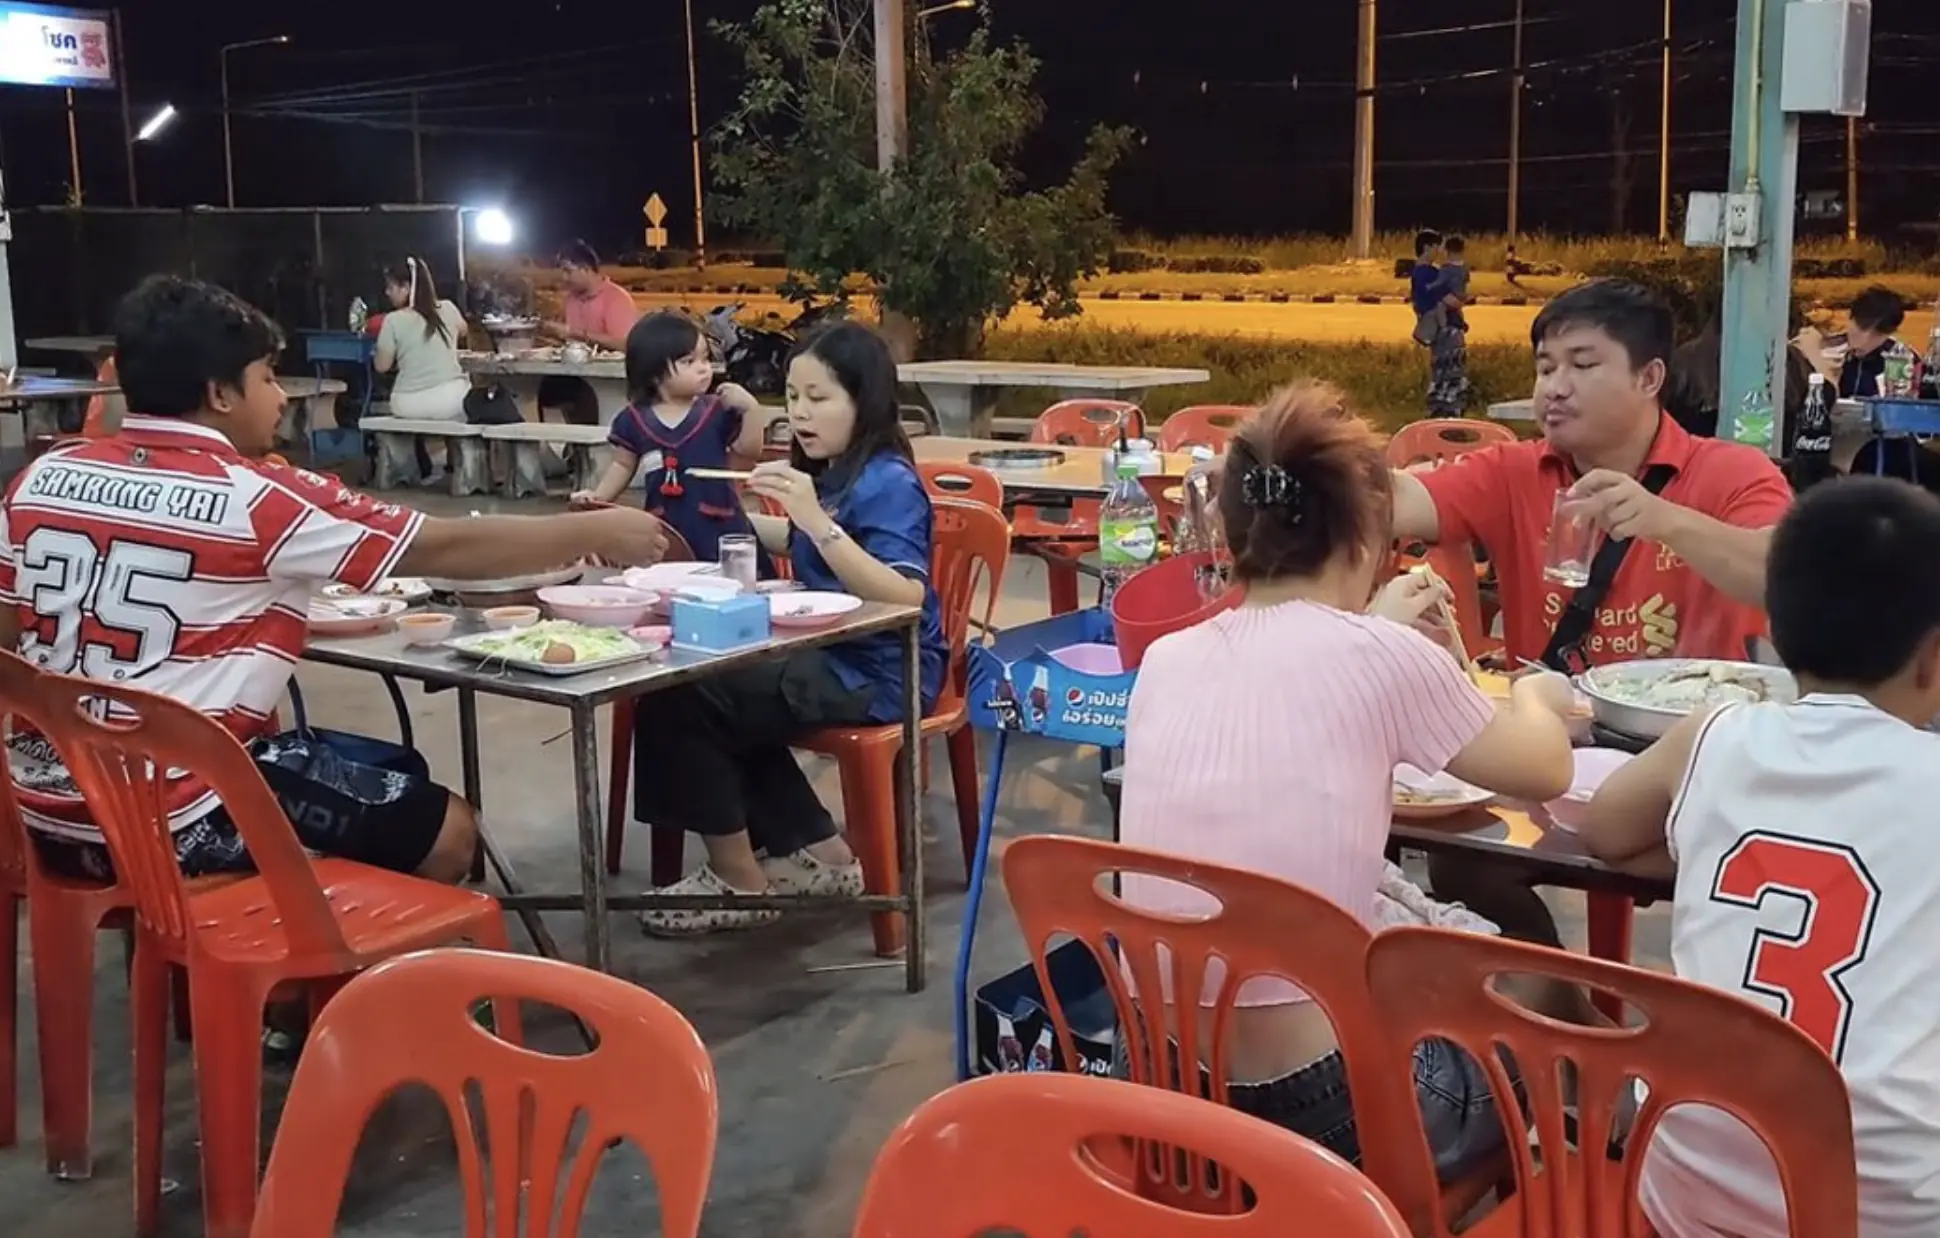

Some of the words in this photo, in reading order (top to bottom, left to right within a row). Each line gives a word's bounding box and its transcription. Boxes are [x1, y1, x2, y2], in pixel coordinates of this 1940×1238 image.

[29, 467, 164, 511] SAMRONG
[166, 487, 229, 525] YAI
[14, 525, 194, 682] 35
[1709, 828, 1882, 1068] 3
